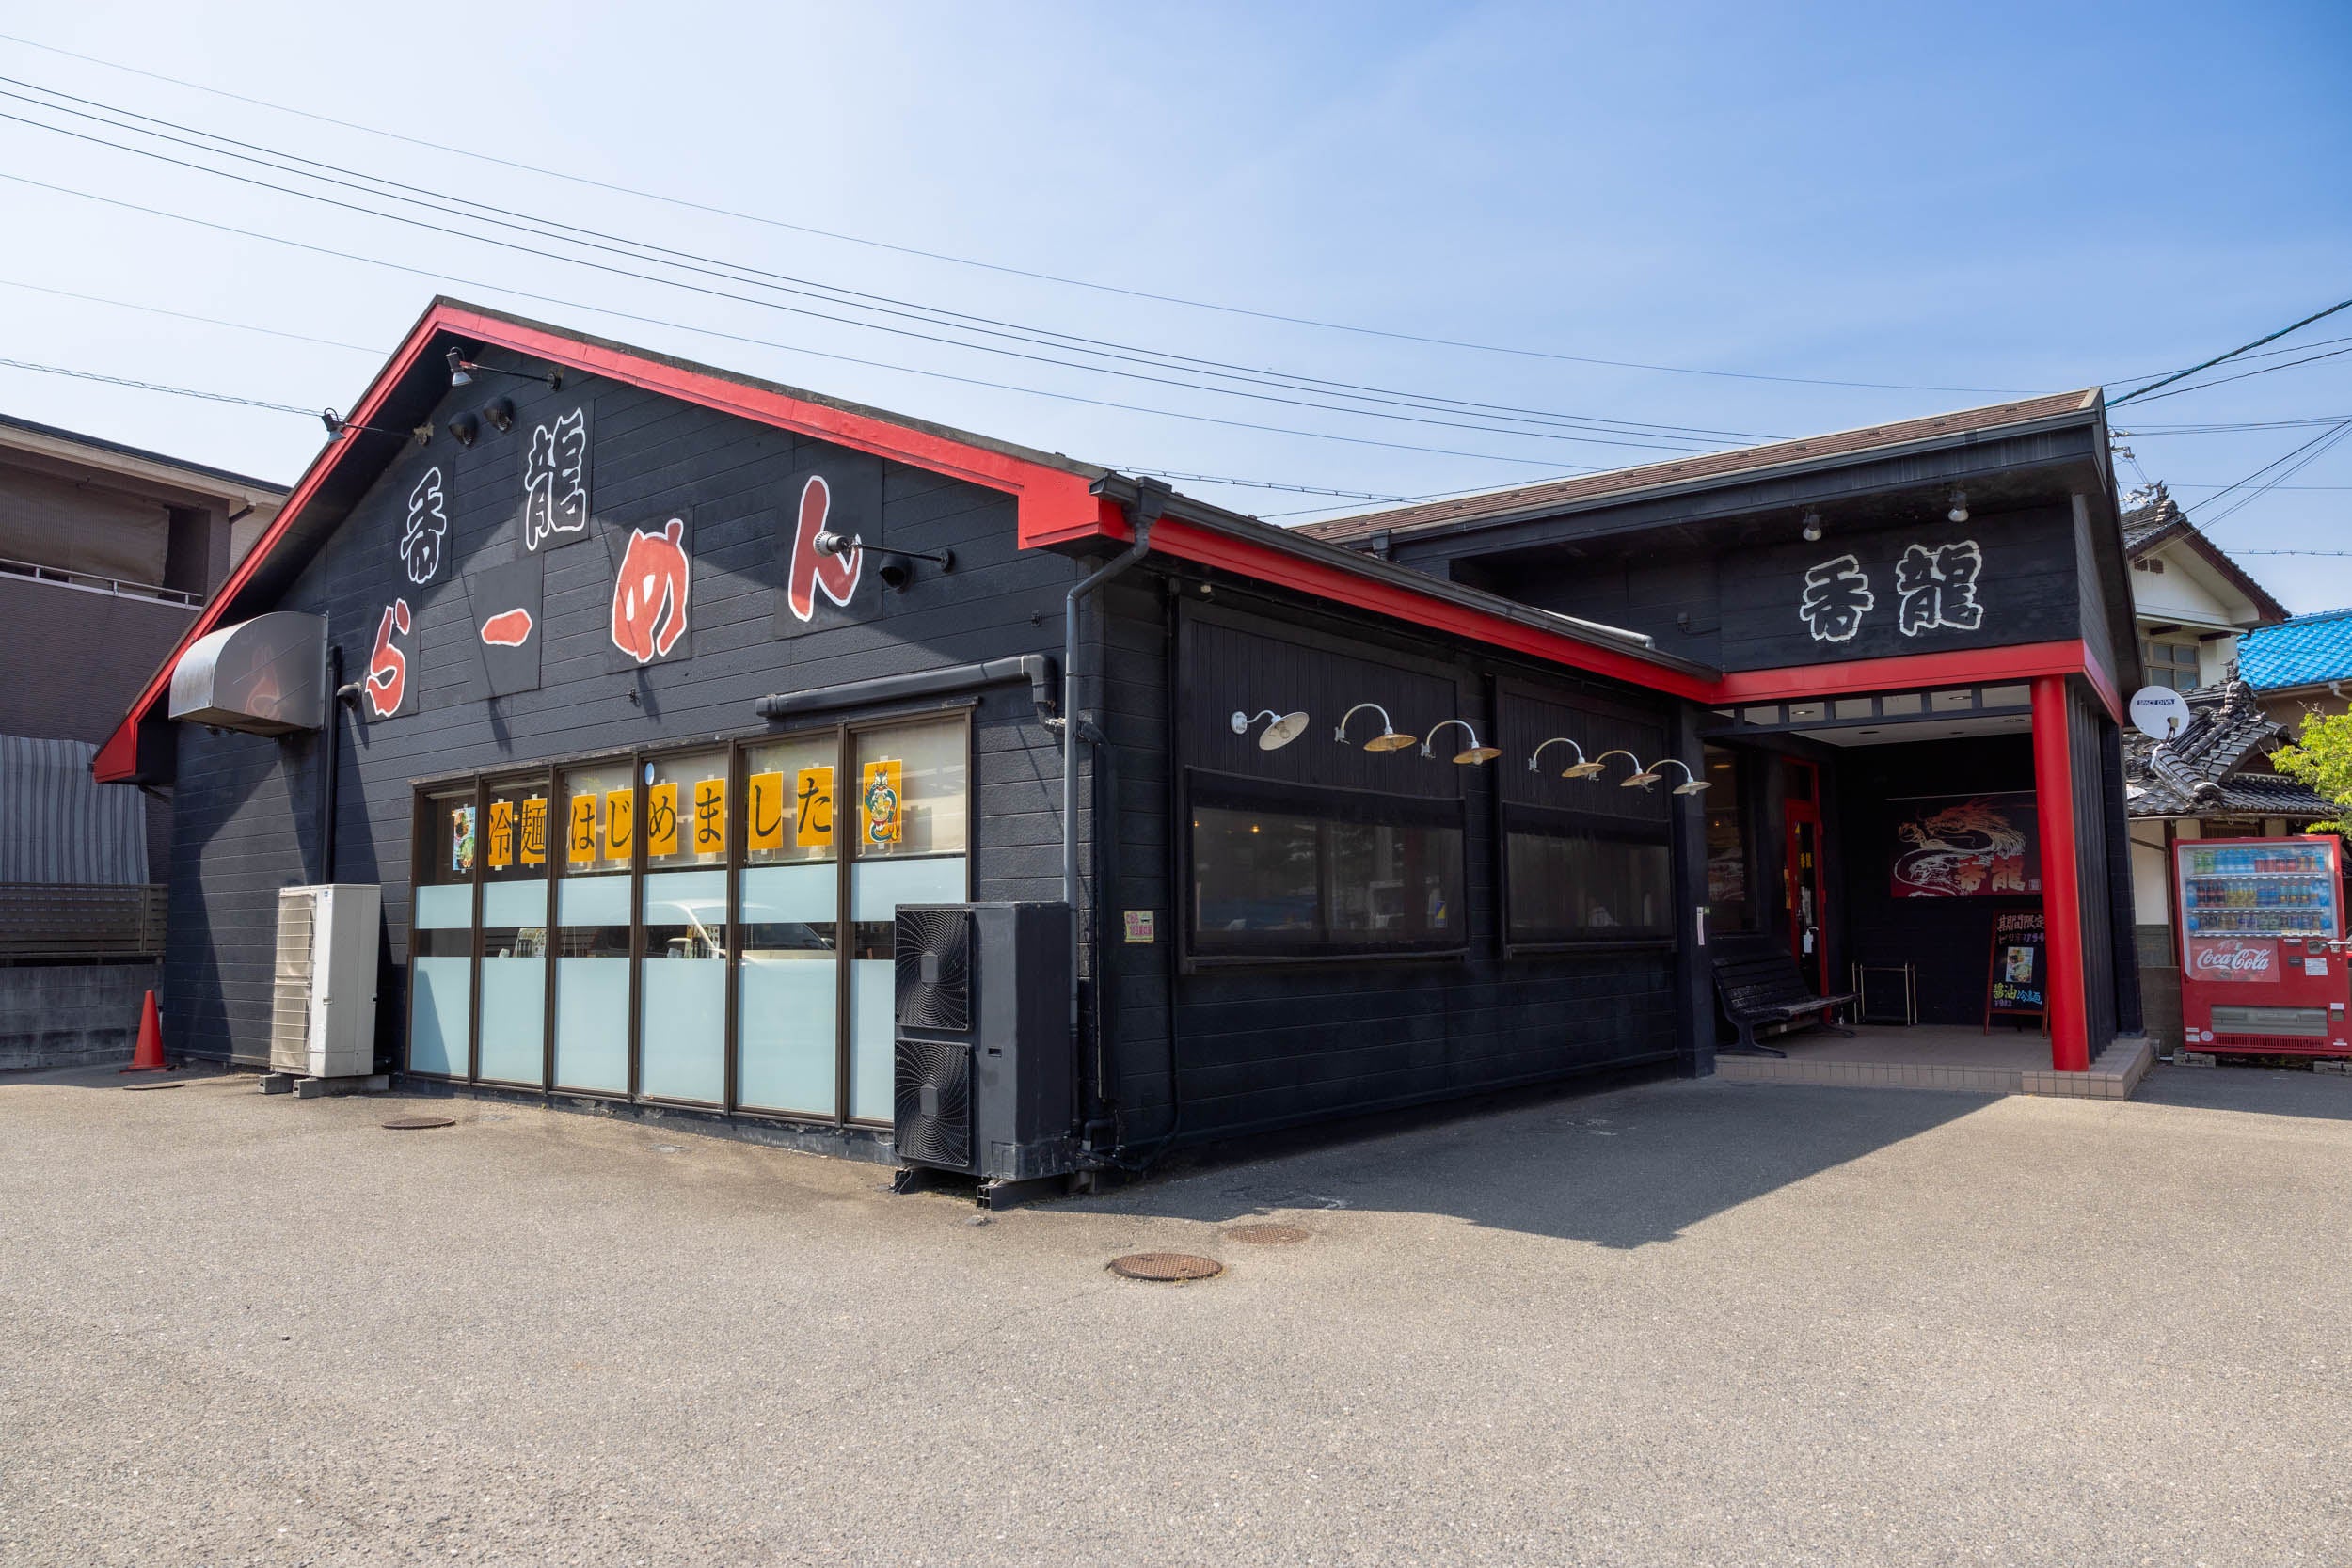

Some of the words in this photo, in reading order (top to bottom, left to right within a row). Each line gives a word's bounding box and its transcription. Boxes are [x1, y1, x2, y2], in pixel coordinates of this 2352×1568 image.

[364, 474, 864, 718] らーめん
[488, 776, 833, 860] 冷麺はじめました
[2197, 948, 2271, 971] Coca-Cola
